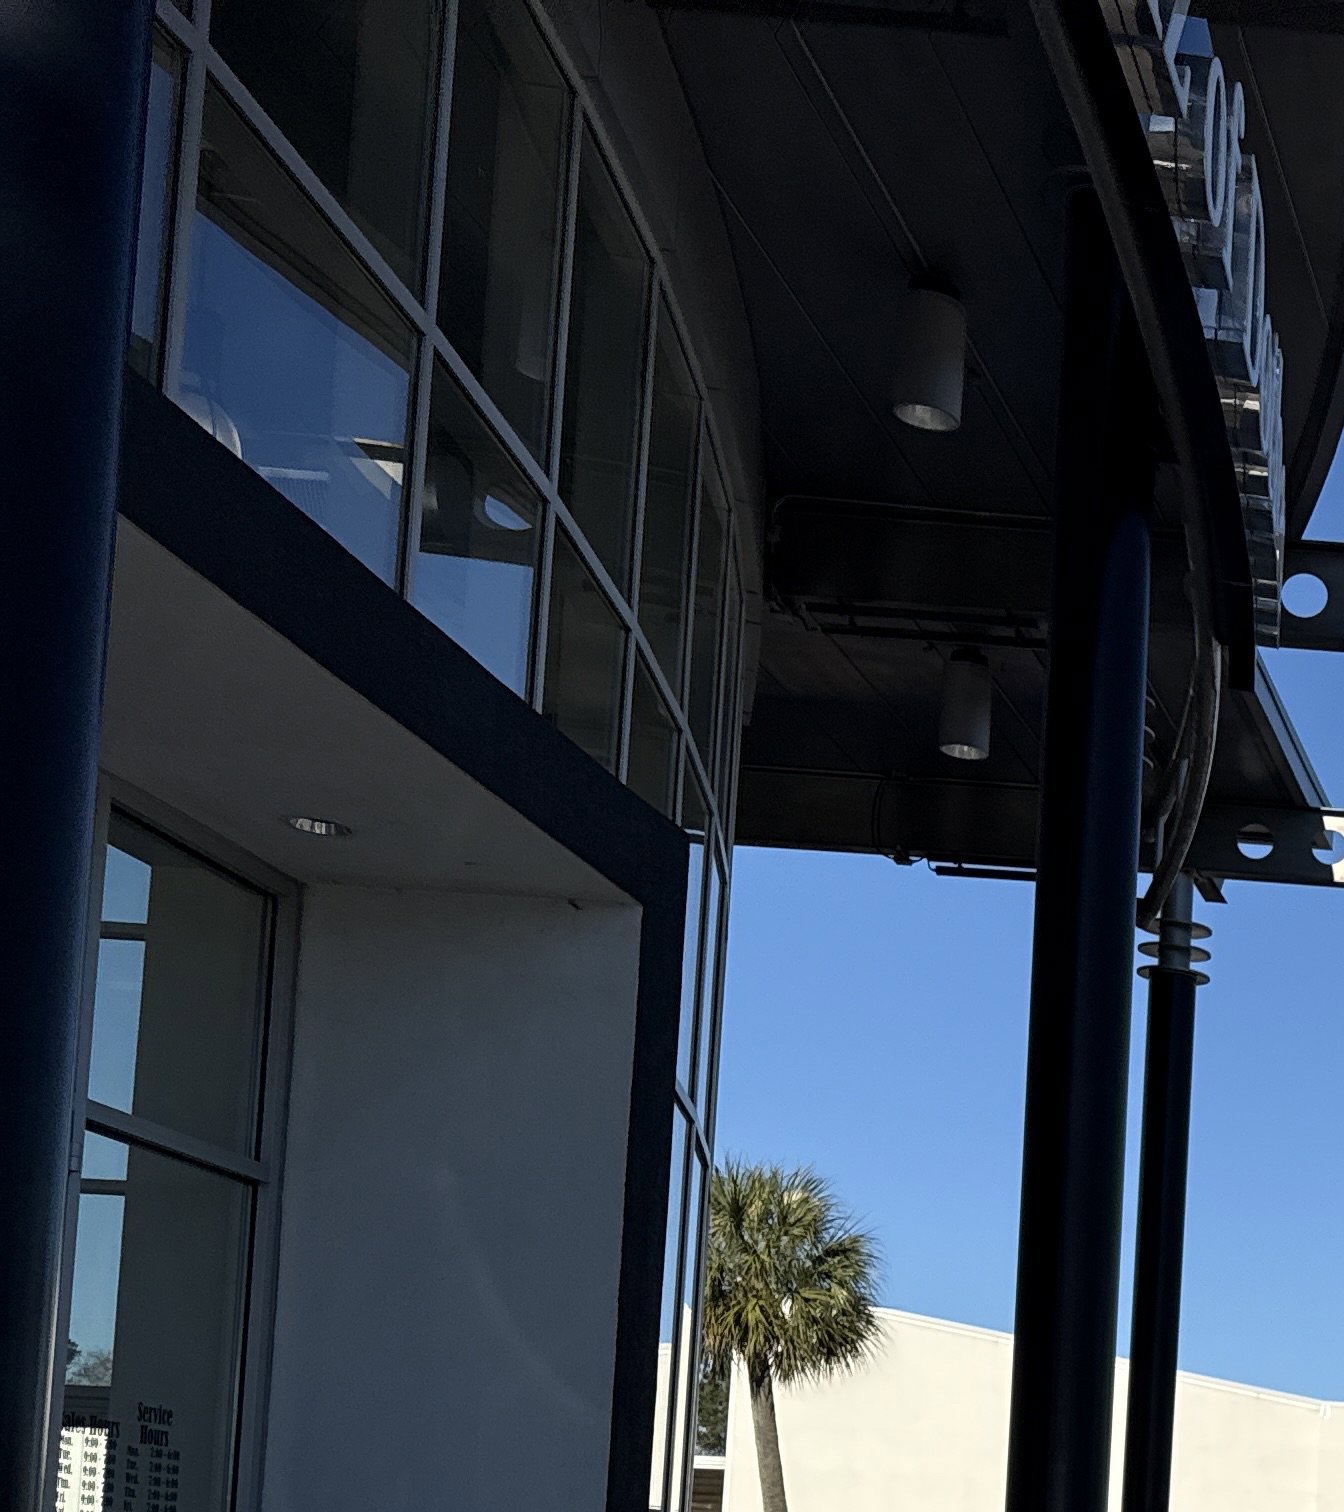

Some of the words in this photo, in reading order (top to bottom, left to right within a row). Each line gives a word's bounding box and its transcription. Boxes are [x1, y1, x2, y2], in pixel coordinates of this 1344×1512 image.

[62, 1411, 86, 1435] ales
[137, 1402, 174, 1426] Service
[139, 1425, 169, 1447] Hours
